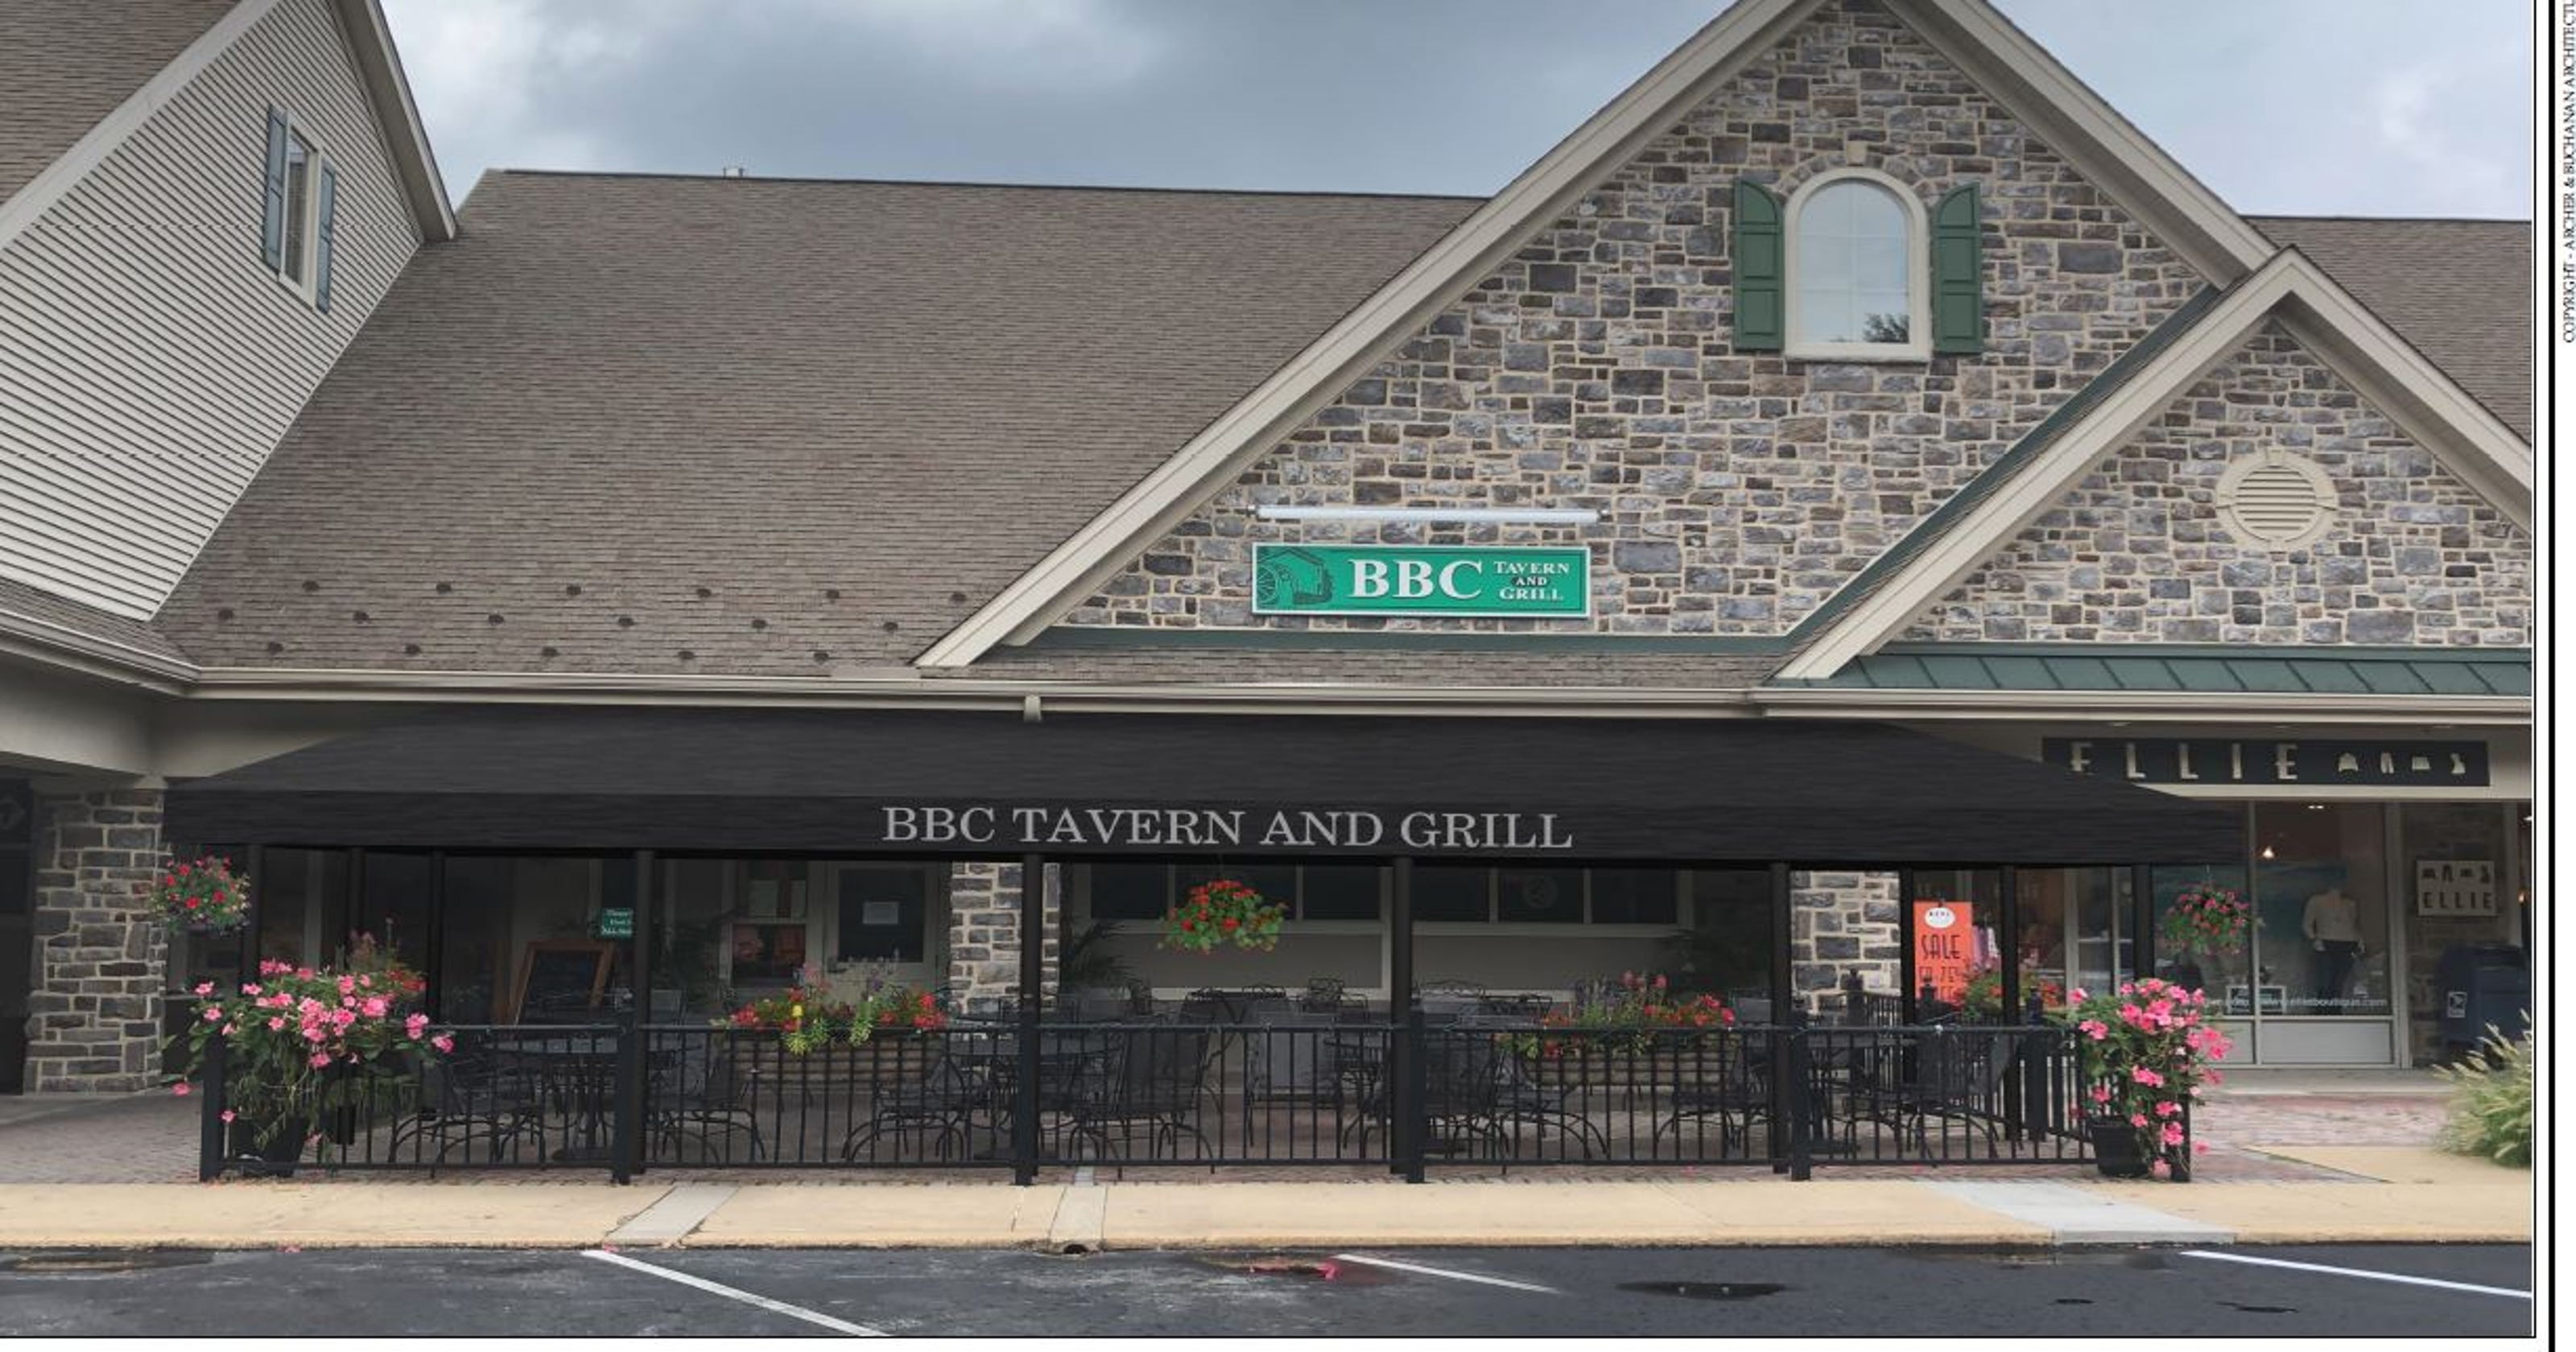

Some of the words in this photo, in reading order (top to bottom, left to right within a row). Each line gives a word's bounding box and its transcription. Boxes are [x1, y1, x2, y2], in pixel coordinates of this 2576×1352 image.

[1492, 561, 1571, 575] TAVERN
[1348, 559, 1483, 600] BBC
[1515, 576, 1548, 587] AND
[1499, 587, 1564, 601] GRILL
[2070, 740, 2299, 780] ELLIE
[881, 806, 996, 843] BBC
[1011, 806, 1247, 846] TAVERN
[1258, 810, 1384, 847] AND
[1399, 811, 1573, 849] GRILL
[2422, 891, 2493, 909] ELLIE
[1921, 934, 1961, 959] SALE
